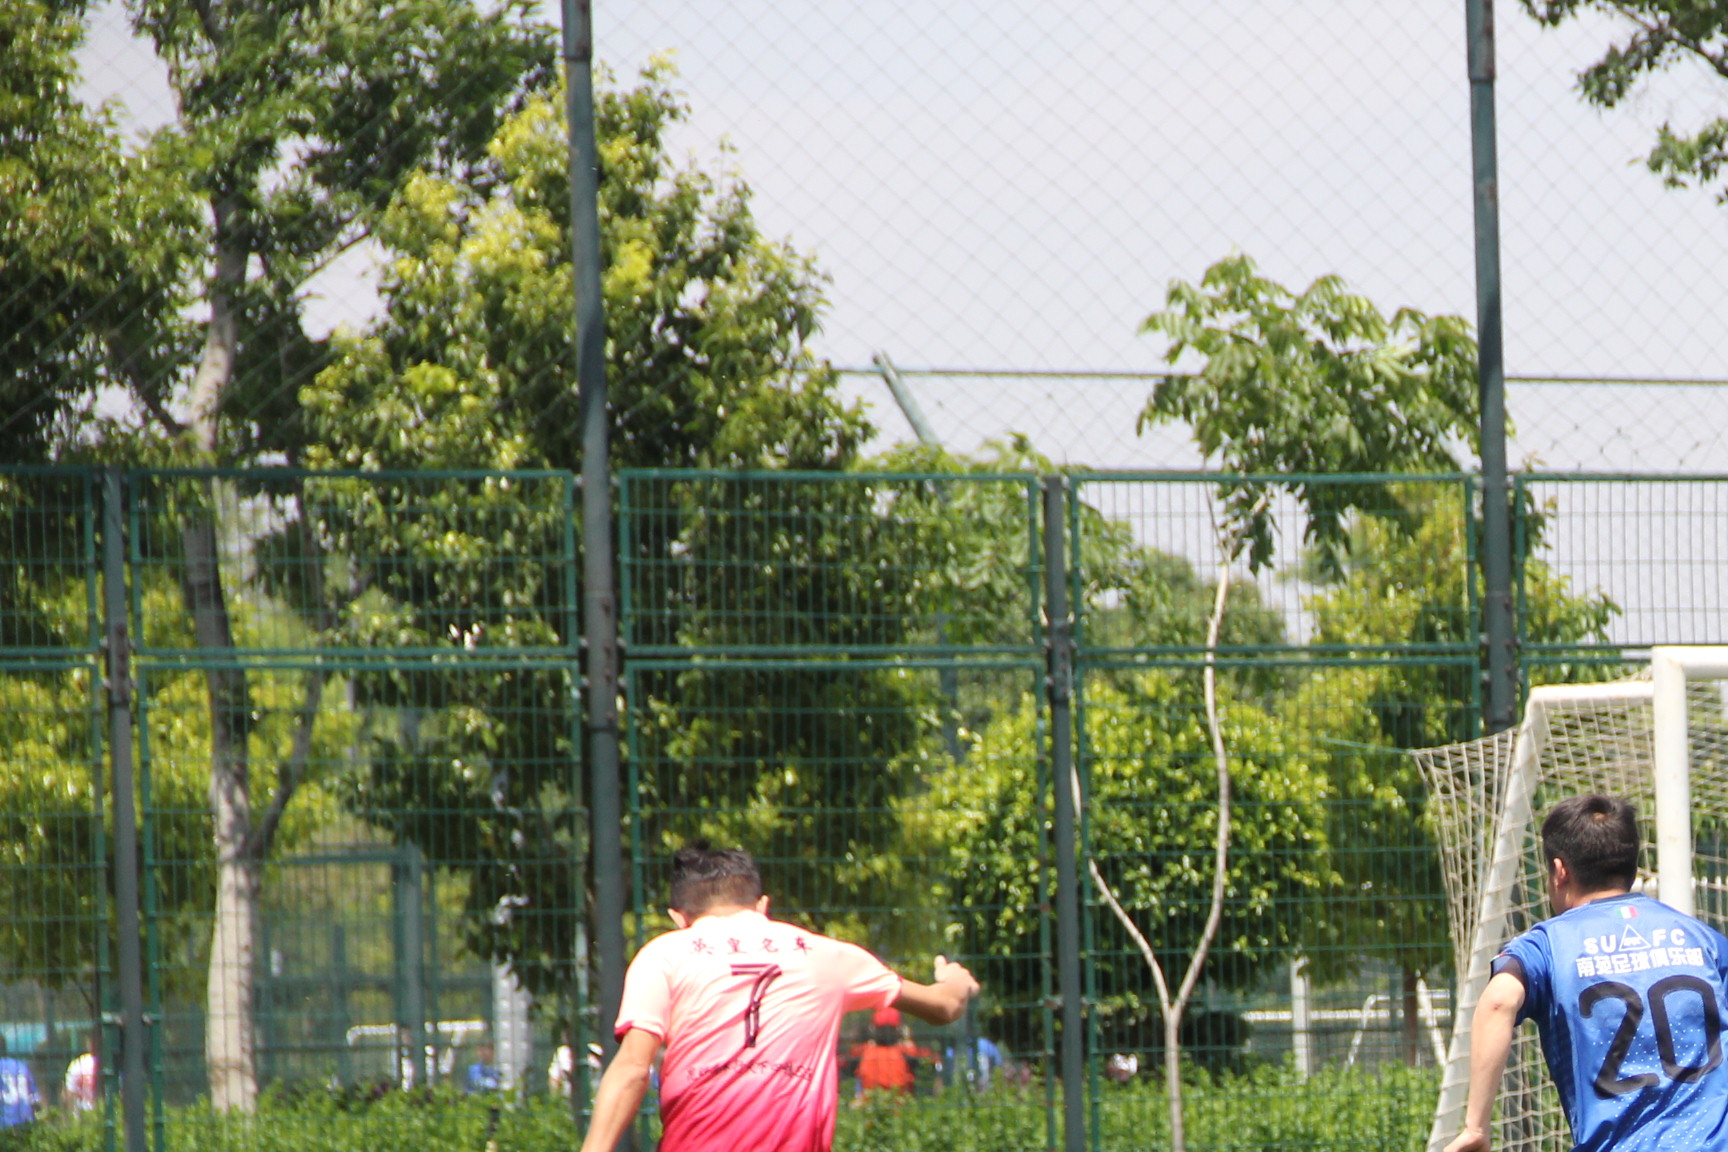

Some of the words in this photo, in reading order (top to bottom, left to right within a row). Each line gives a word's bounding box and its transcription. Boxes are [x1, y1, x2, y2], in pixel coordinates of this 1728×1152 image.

[1576, 948, 1704, 977] 南苑足球俱乐部
[1583, 934, 1617, 955] SU
[1652, 928, 1686, 946] FC
[730, 963, 782, 1048] 7
[1578, 975, 1722, 1098] 20
